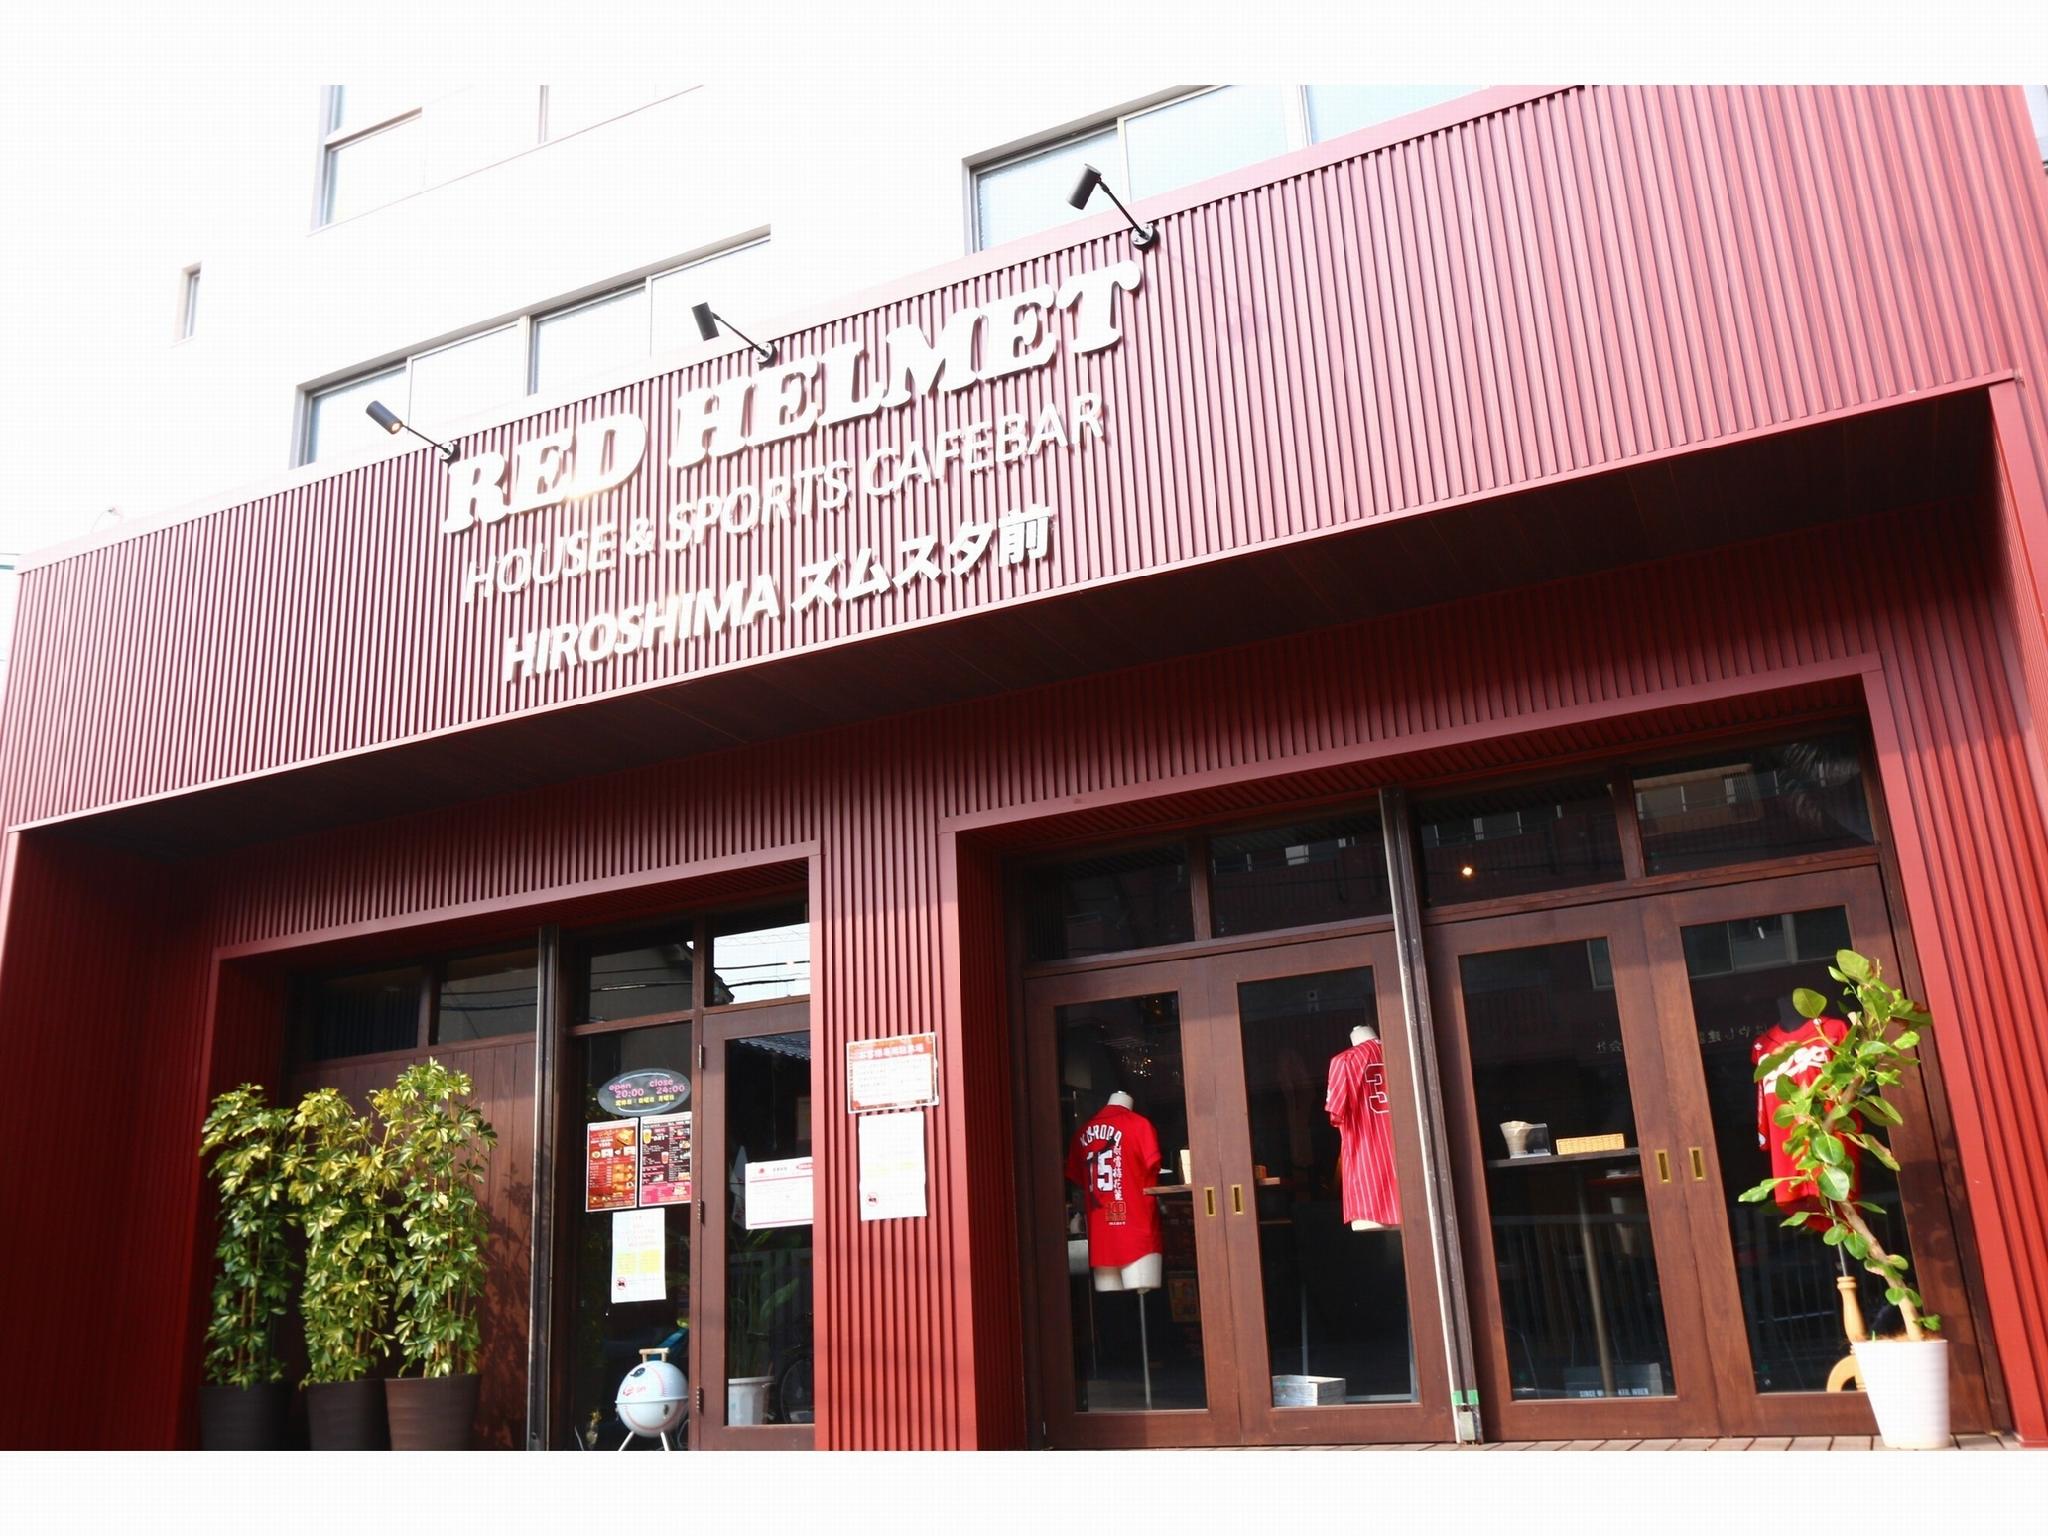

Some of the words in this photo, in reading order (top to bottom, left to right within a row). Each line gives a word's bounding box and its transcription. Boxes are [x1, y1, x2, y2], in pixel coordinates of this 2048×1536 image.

[443, 412, 649, 534] RED
[668, 260, 1142, 470] HELMET
[464, 520, 618, 604] HOUSE
[626, 517, 655, 556] &
[664, 458, 853, 551] SPORTS
[862, 391, 1106, 497] CAFEBAR
[504, 573, 781, 683] HIROSHIMA
[790, 503, 1054, 614] ズムスタ前
[608, 1083, 632, 1093] open
[649, 1078, 674, 1087] close
